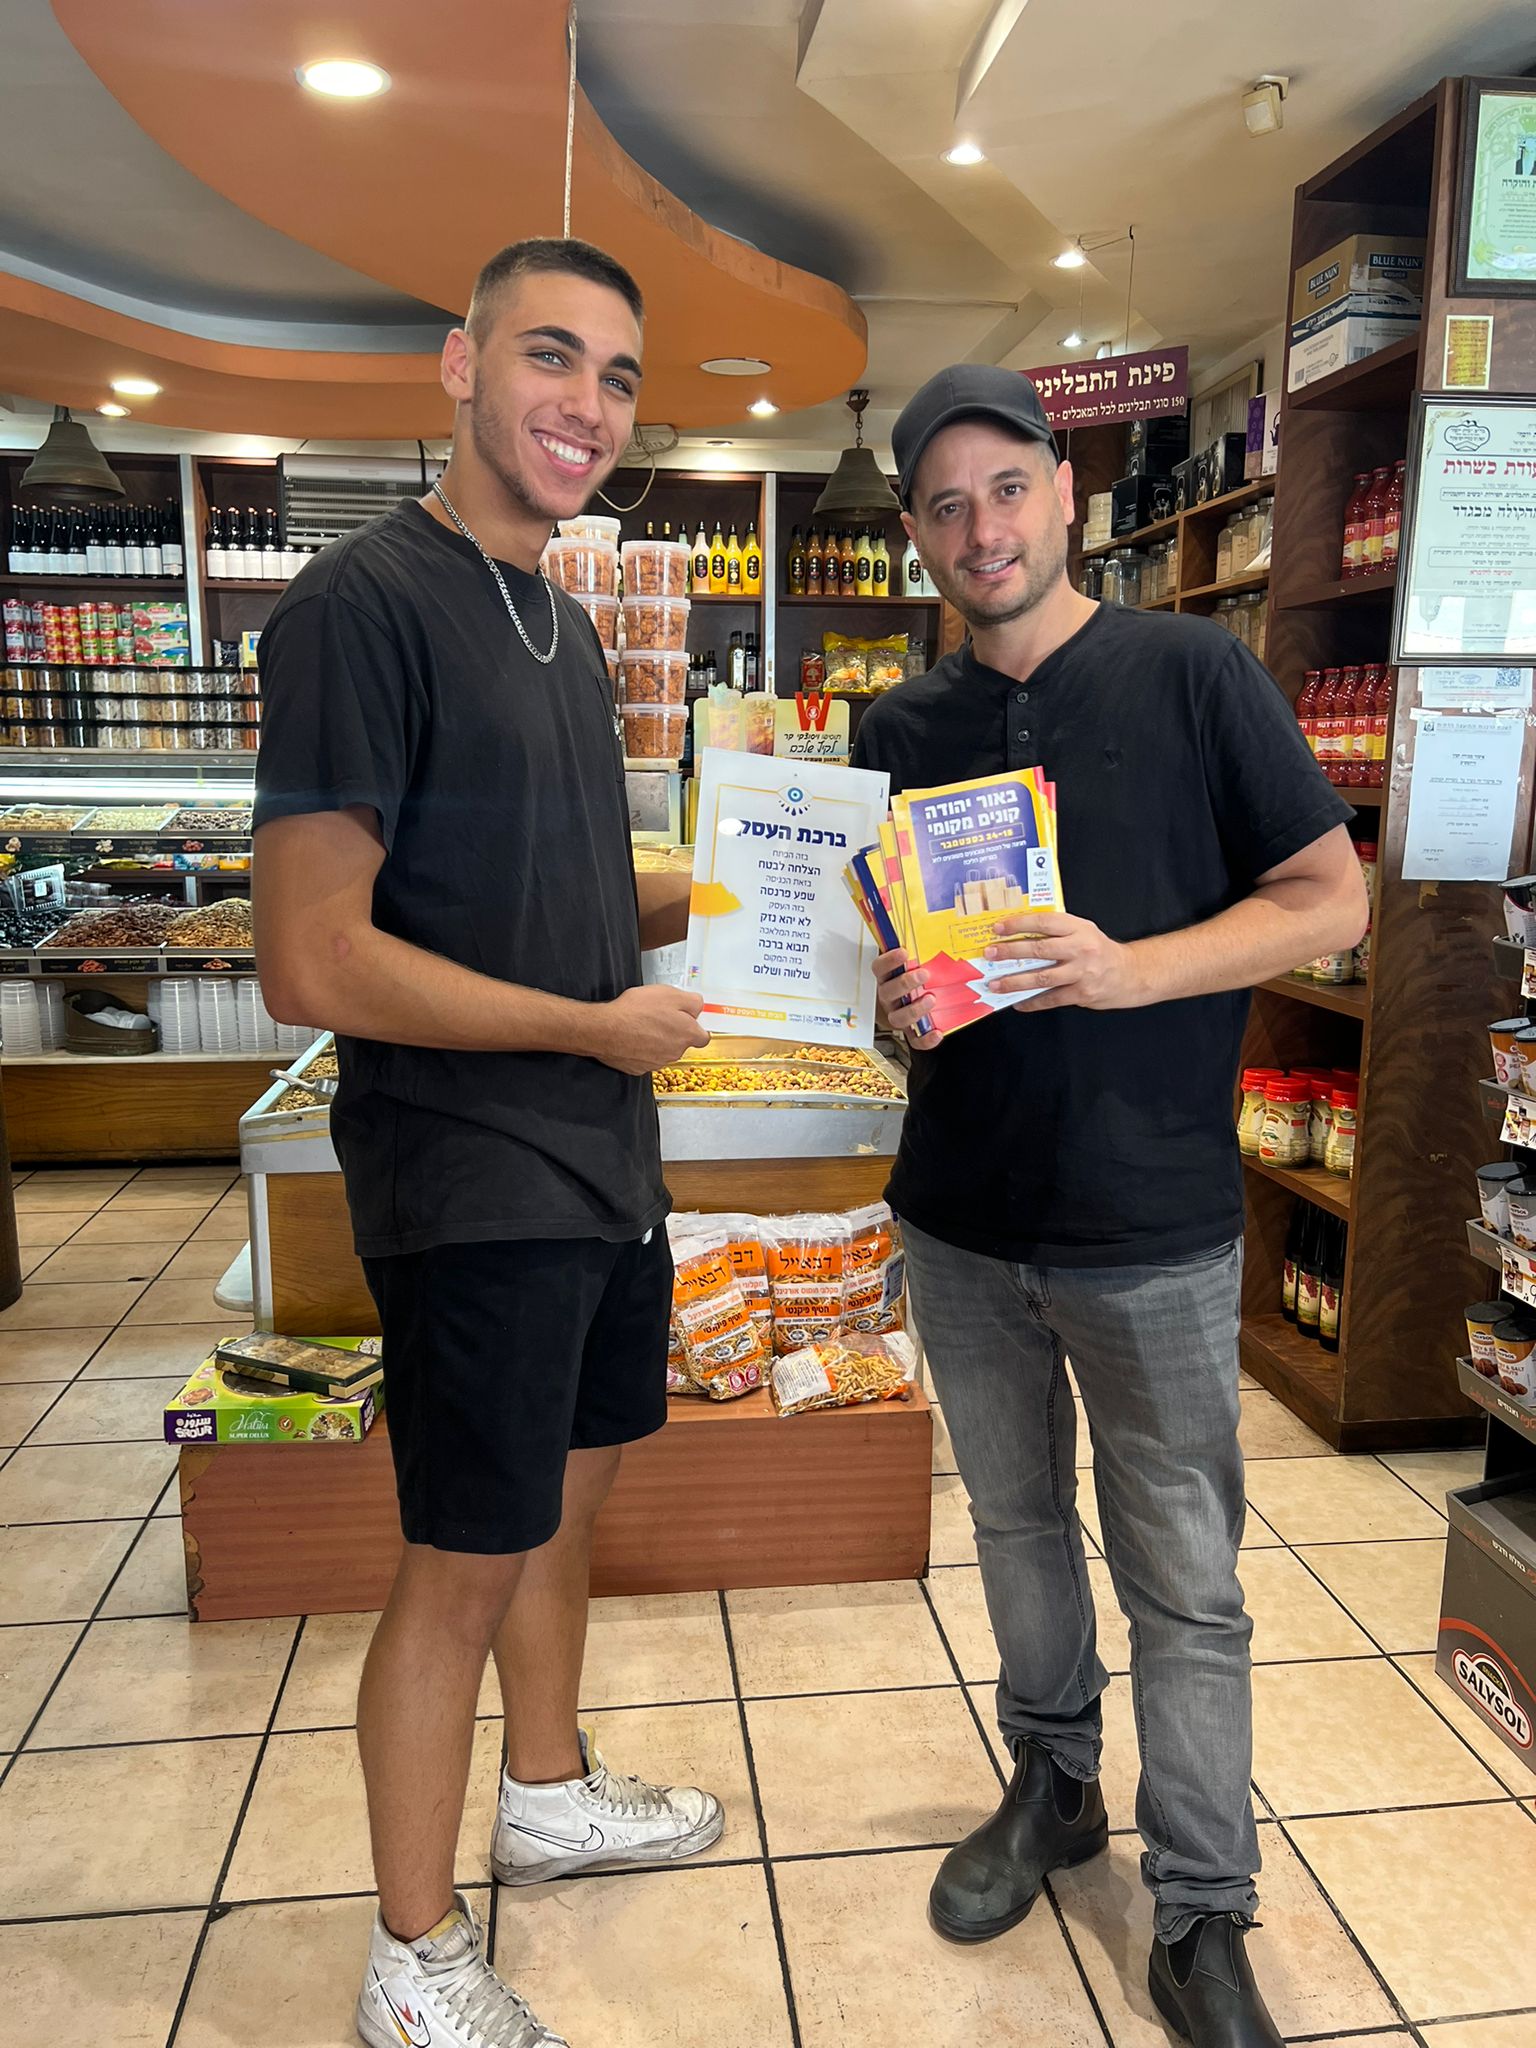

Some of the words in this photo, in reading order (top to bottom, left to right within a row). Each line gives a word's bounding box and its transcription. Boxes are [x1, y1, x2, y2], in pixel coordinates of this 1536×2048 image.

[1372, 256, 1395, 266] BLUE
[1397, 257, 1419, 267] NUN
[1310, 276, 1324, 289] BLUE
[1324, 267, 1338, 280] NUN
[1127, 361, 1176, 388] פינת
[1035, 368, 1118, 398] התבליני
[1118, 398, 1151, 413] תבלינים
[1153, 399, 1170, 410] סוגי
[1172, 397, 1185, 407] 150
[1062, 403, 1099, 421] המאכלים
[1100, 401, 1116, 416] לכל
[1443, 459, 1497, 475] כשרות
[1453, 506, 1493, 518] מבגדד
[795, 691, 833, 732] W
[784, 733, 794, 741] קר
[797, 732, 821, 741] ויסוצקי
[790, 739, 815, 753] שלכם
[817, 740, 838, 755] לקיץ
[976, 788, 1019, 807] באור
[925, 798, 972, 820] יהודה
[978, 806, 1021, 826] קונים
[738, 819, 792, 841] העסק
[928, 817, 975, 837] מקומי
[797, 826, 847, 848] ברכת
[940, 836, 985, 849] בספטמבר
[795, 853, 809, 861] בזה
[758, 859, 785, 871] לבטח
[788, 863, 821, 876] הצלחה
[766, 875, 791, 885] הכניסה
[793, 878, 812, 888] בזאת
[760, 886, 791, 898] פרנסה
[793, 890, 816, 901] שפע
[769, 901, 790, 911] העסק
[792, 904, 805, 913] בזה
[760, 912, 777, 923] נזק
[779, 914, 796, 925] יהא
[798, 916, 812, 927] לא
[760, 926, 790, 937] המלאכה
[792, 930, 810, 940] בזאת
[759, 939, 783, 950] ברכה
[786, 942, 810, 953] תבוא
[764, 953, 787, 963] המקום
[789, 956, 803, 965] בזה
[753, 964, 781, 976] ושלום
[784, 968, 811, 979] שלווה
[780, 1251, 832, 1270] דבאייל
[676, 1266, 726, 1289] דבאייל
[775, 1287, 799, 1295] אורגינל
[848, 1298, 871, 1308] פיקנטי
[785, 1307, 810, 1317] פיקנטי
[811, 1305, 830, 1316] חטיף
[728, 1312, 743, 1325] חטיף
[175, 1426, 213, 1438] SROUR
[1459, 1660, 1526, 1740] SALYSOL
